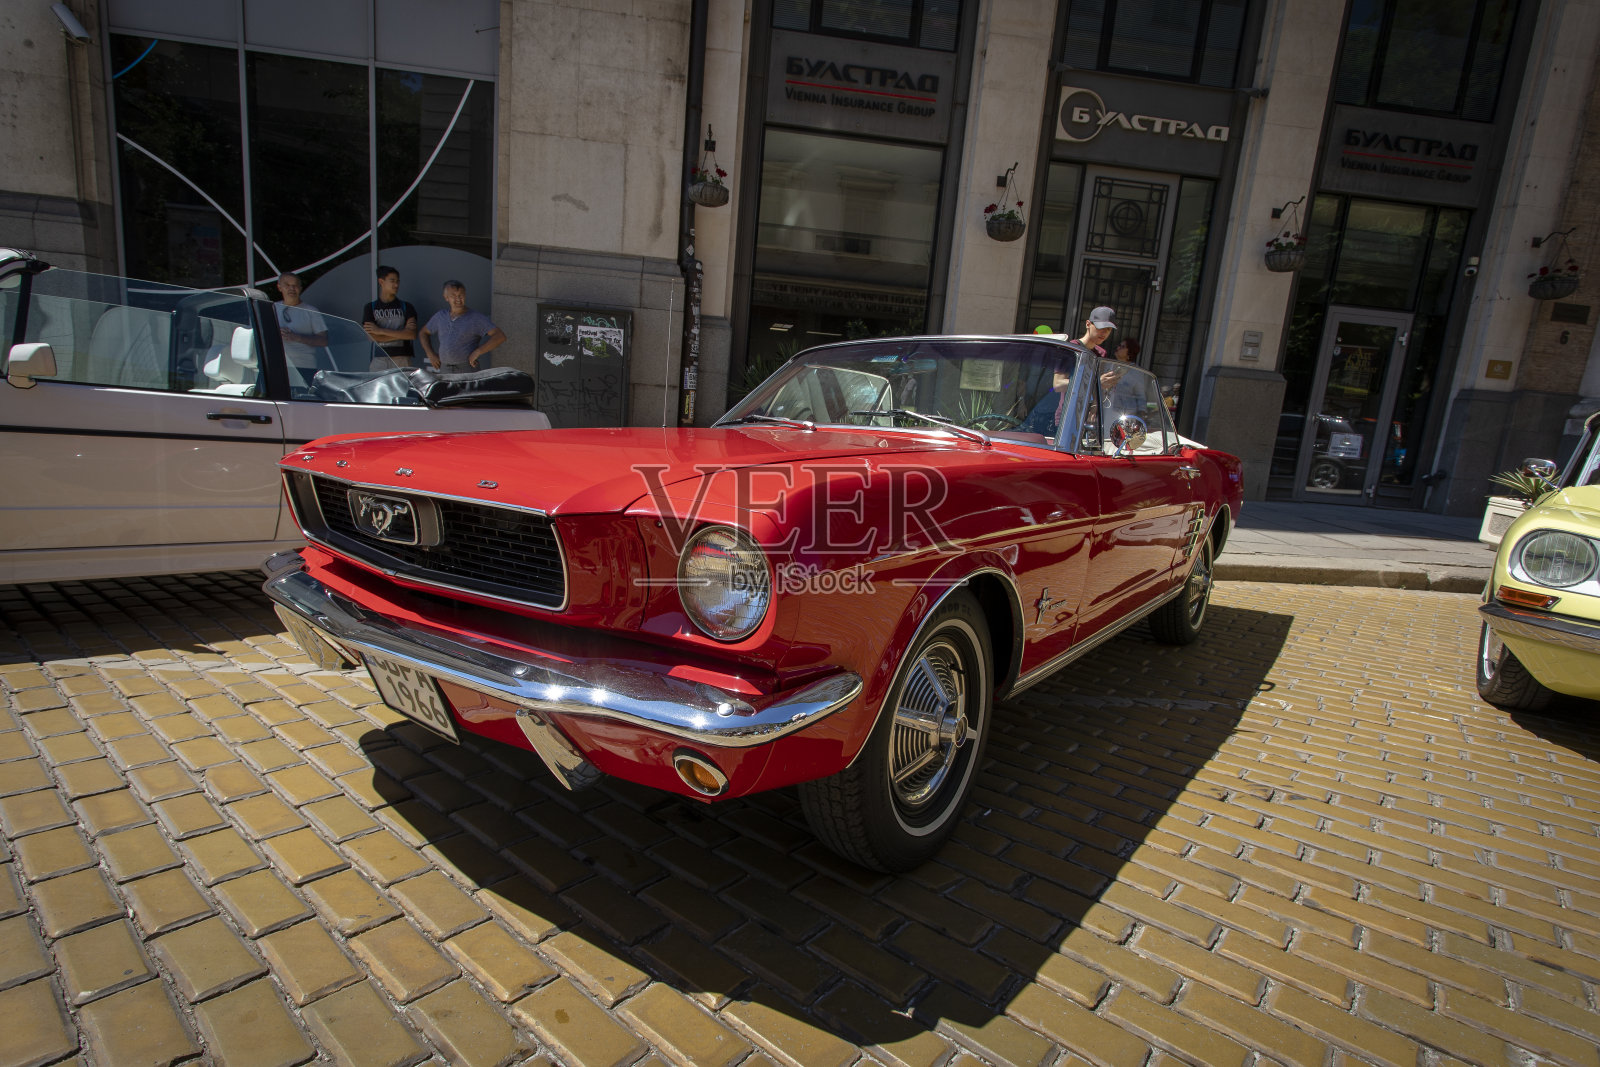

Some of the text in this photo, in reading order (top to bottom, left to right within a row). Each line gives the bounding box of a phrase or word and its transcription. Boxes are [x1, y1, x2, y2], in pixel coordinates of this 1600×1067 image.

[785, 56, 939, 94] БУЛСТРАД
[1072, 106, 1230, 142] БУЛСТРАД
[1343, 128, 1479, 161] БУЛСТРАД
[373, 308, 403, 320] ROOKLY
[1559, 330, 1570, 345] 6
[385, 674, 449, 730] 1966
